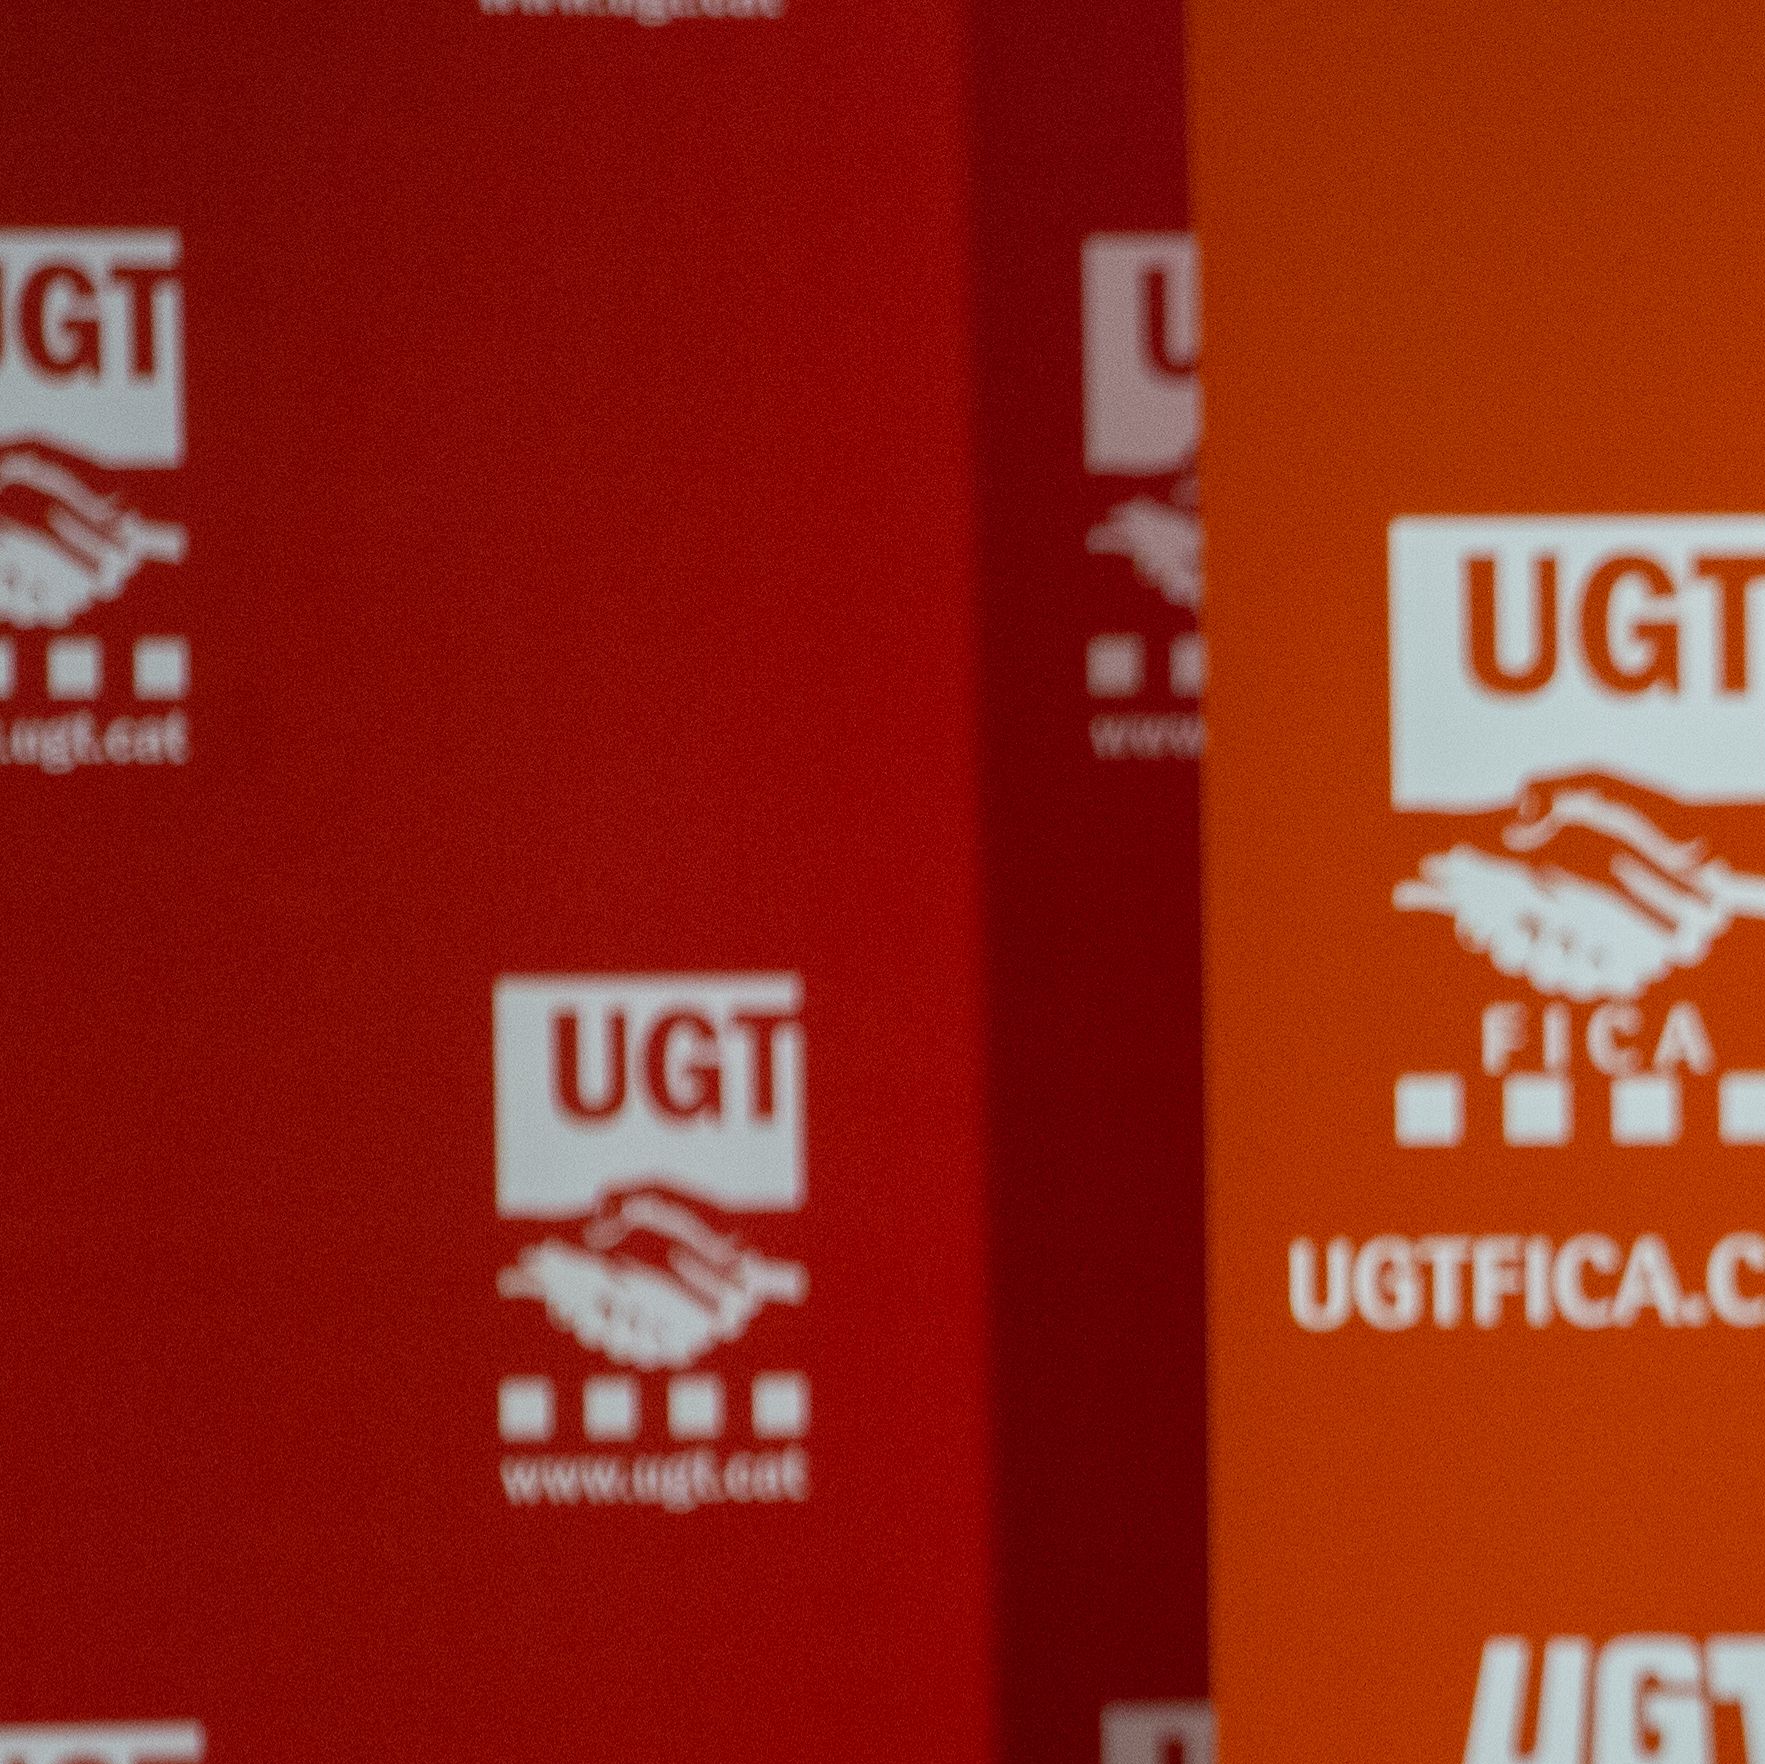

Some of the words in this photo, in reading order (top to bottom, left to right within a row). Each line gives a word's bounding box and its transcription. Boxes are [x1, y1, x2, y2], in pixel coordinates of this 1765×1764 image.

[0, 264, 183, 380] GT
[552, 1007, 802, 1128] UGT
[1481, 1000, 1715, 1076] FICA
[500, 1444, 807, 1513] www.ugt.cat
